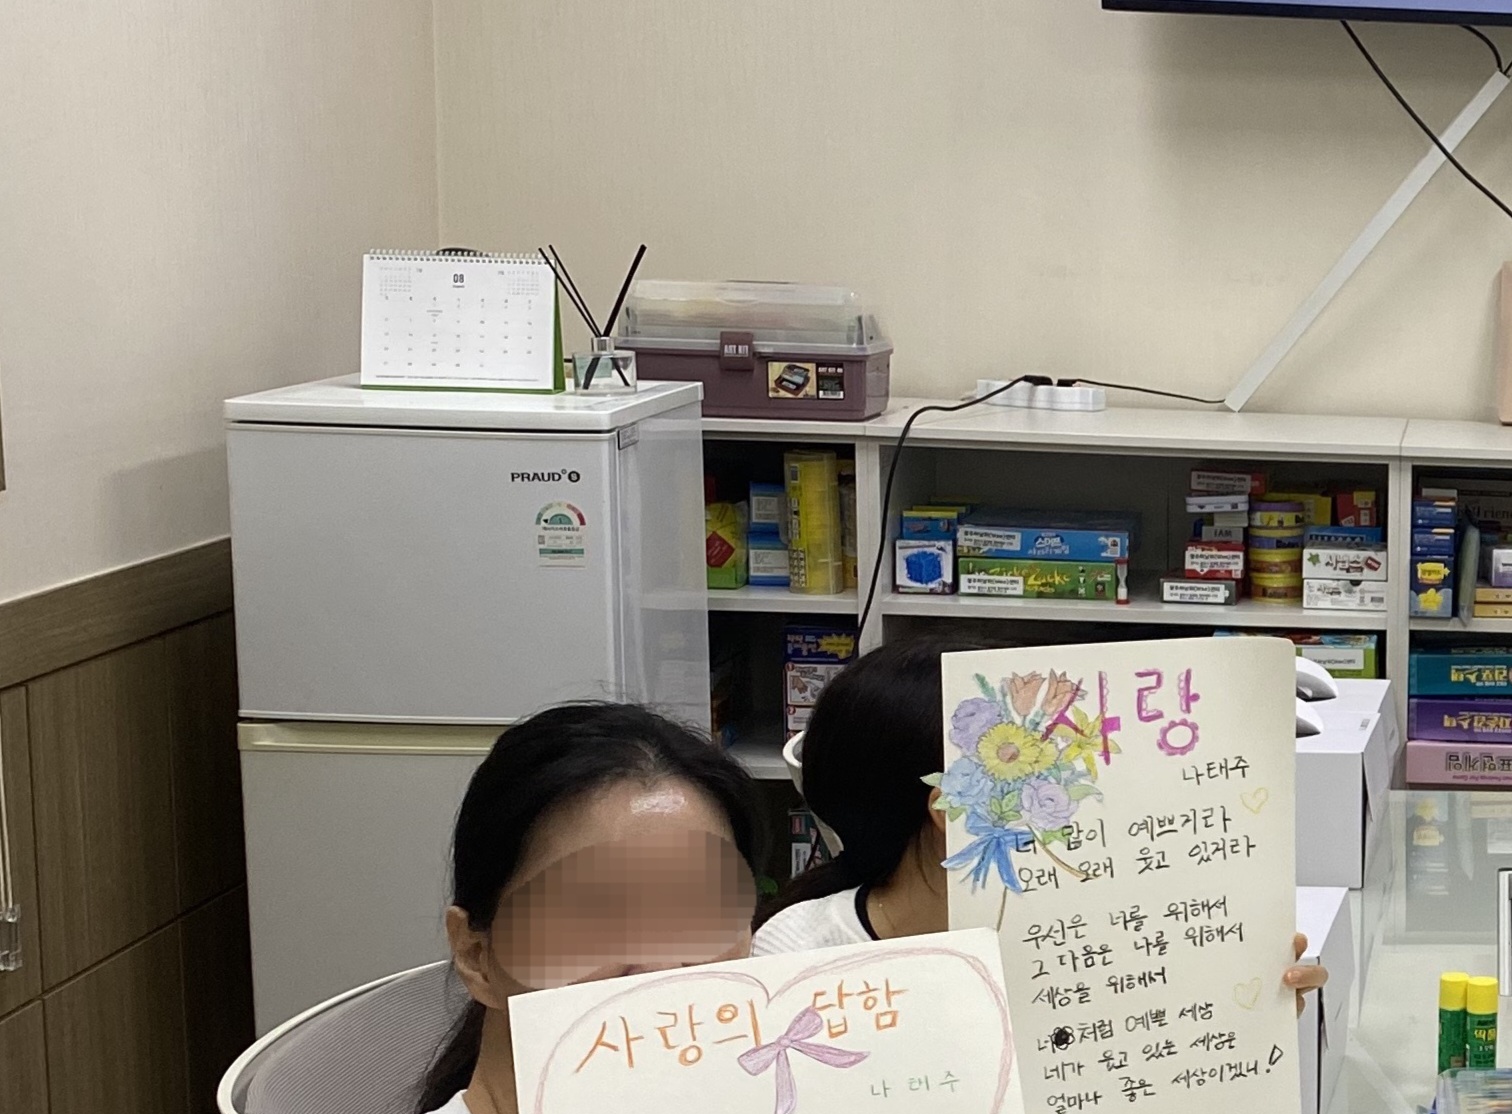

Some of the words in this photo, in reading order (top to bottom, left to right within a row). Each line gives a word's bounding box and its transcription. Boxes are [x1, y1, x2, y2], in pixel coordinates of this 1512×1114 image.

[453, 274, 464, 283] 08
[510, 472, 562, 482] PRAUD
[1041, 668, 1200, 765] 사랑
[1182, 756, 1250, 785] 나태주
[1018, 867, 1059, 892] 오래
[1078, 857, 1115, 883] 오래
[1135, 847, 1170, 874] 웃고
[1023, 914, 1088, 949] 우선은
[1109, 905, 1148, 932] 너를
[1163, 896, 1228, 923] 위해서
[1134, 930, 1169, 956] 나를
[1184, 922, 1244, 947] 위해서
[1031, 982, 1091, 1009] 세상을
[1106, 967, 1167, 994] 위해서
[574, 998, 765, 1075] 사랑의
[812, 978, 909, 1041] 답함
[1125, 1009, 1168, 1031] 예쁜
[1179, 1002, 1213, 1022] 세상
[1044, 1061, 1085, 1081] 네가
[1142, 1039, 1178, 1061] 있는
[1190, 1032, 1237, 1052] 세상은
[1047, 1091, 1102, 1114] 얼마나
[1119, 1076, 1156, 1102] 좋은
